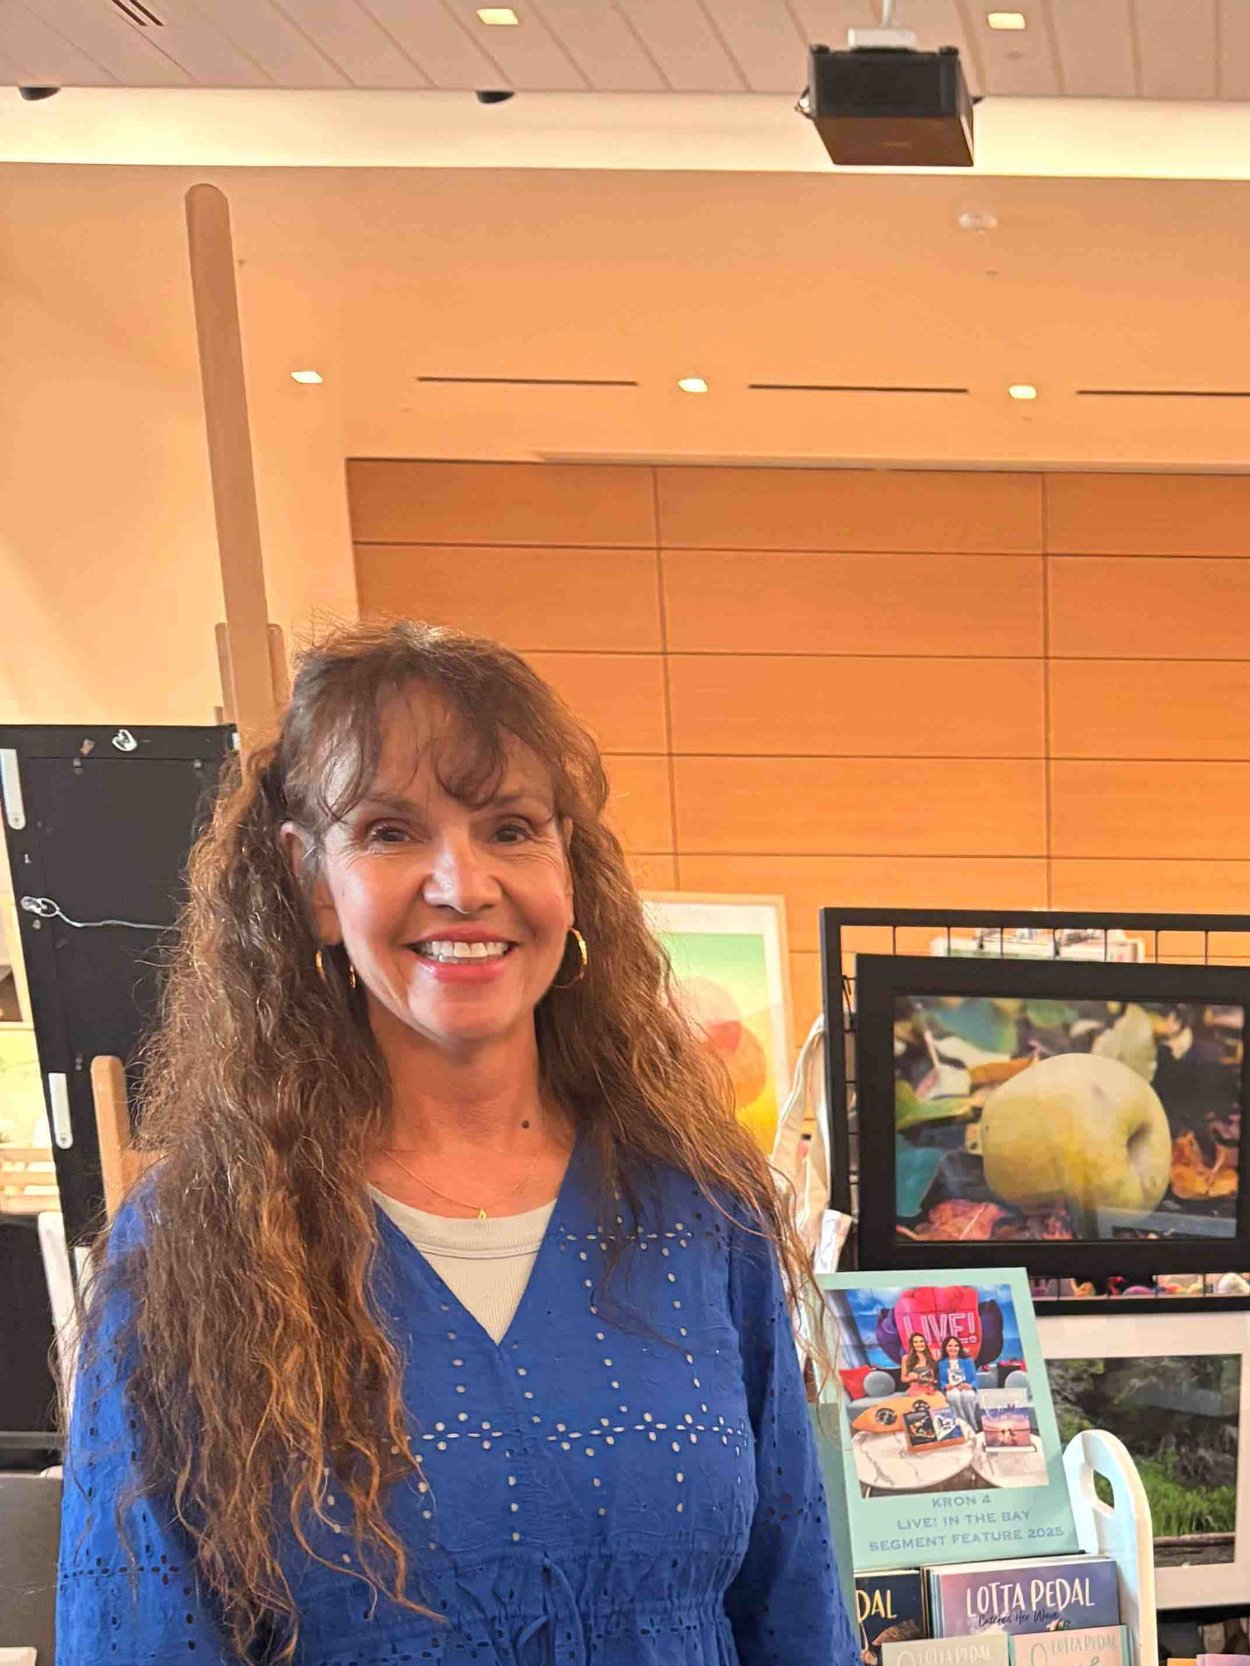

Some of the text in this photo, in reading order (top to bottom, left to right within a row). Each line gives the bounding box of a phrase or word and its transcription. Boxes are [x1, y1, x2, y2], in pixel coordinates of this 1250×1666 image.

[932, 1494, 991, 1507] KRON 4
[897, 1510, 1031, 1530] LIVE! IN THE BAY
[869, 1526, 1064, 1551] SEGMENT FEATURE 2025
[855, 1589, 898, 1624] DAL
[966, 1577, 1095, 1618] LOTTA PEDAL
